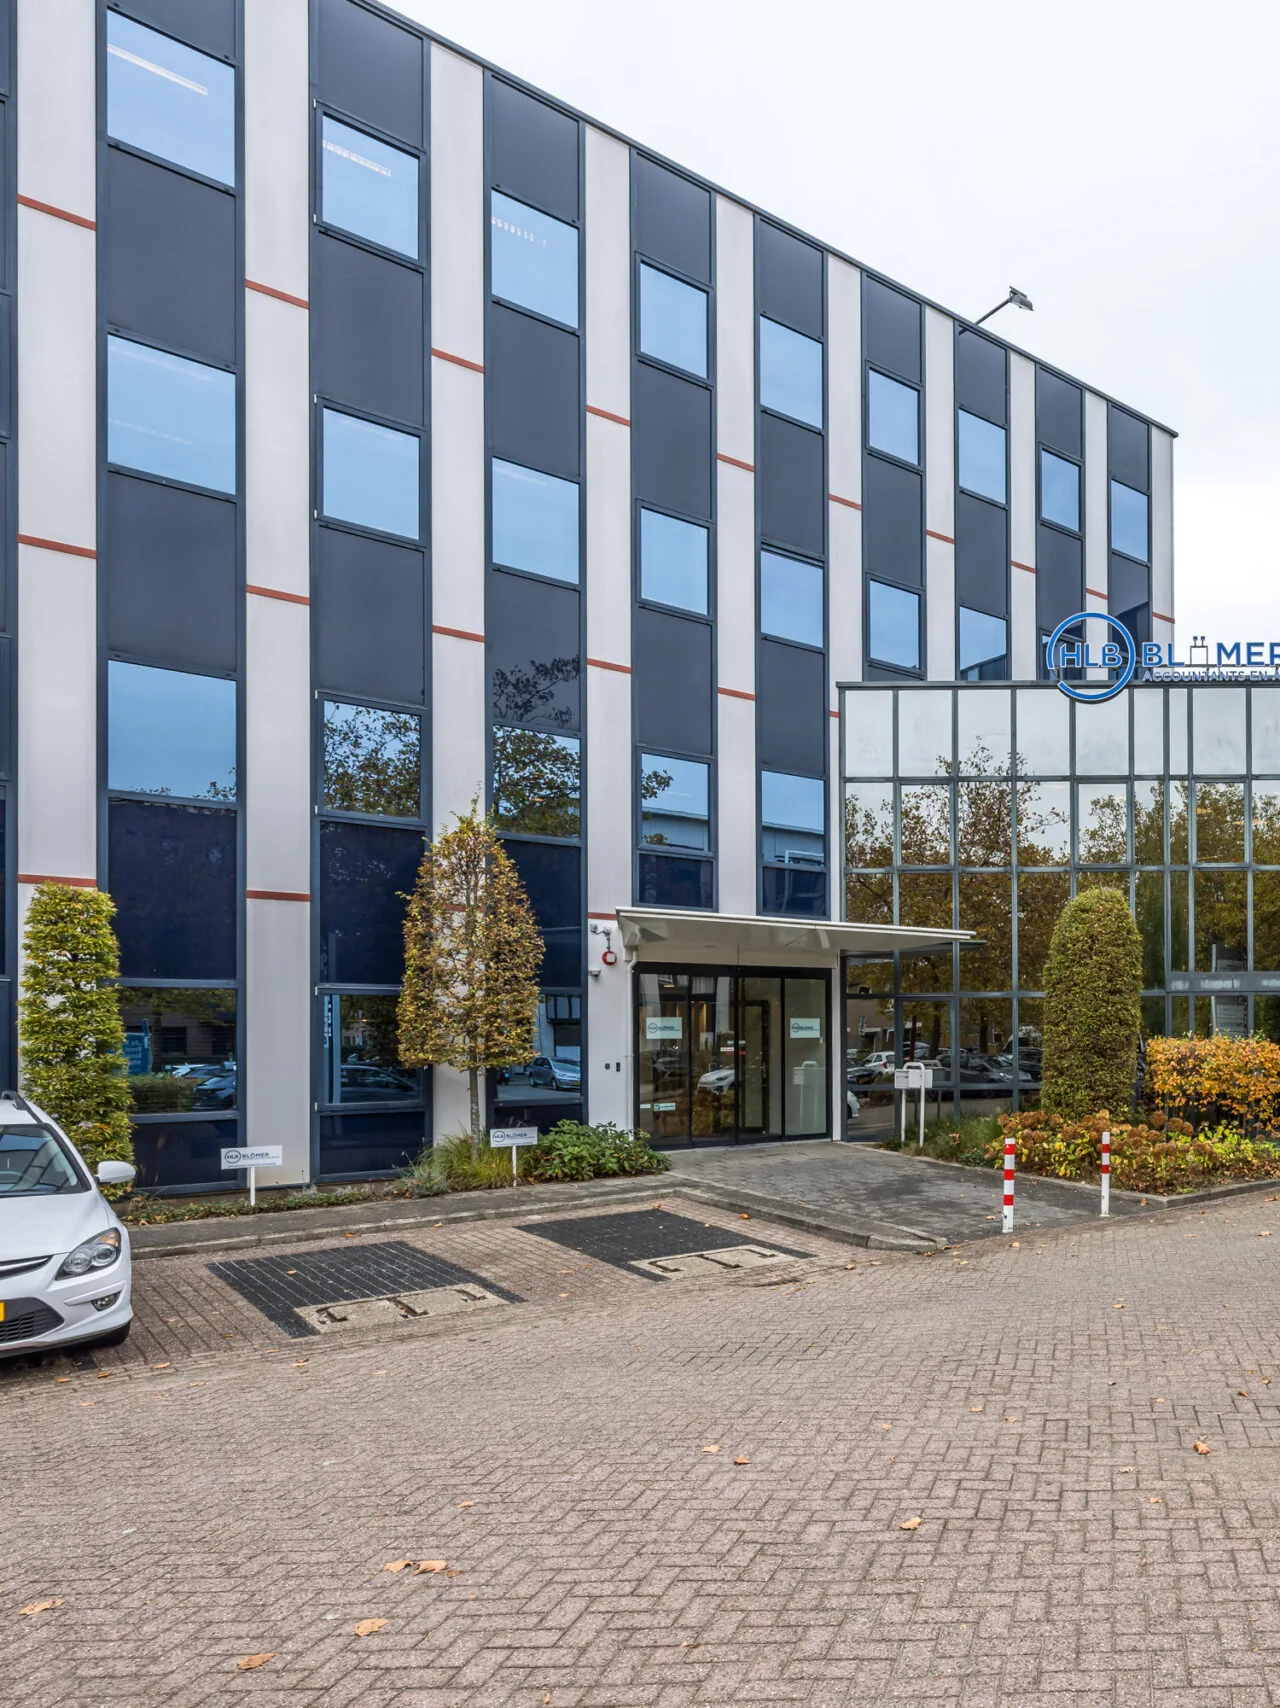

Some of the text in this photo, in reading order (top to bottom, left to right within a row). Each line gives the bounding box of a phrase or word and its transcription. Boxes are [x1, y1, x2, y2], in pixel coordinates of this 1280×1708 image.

[1060, 642, 1123, 668] HLB
[1142, 670, 1246, 682] ACCOUNTANTS
[1250, 670, 1268, 681] EN
